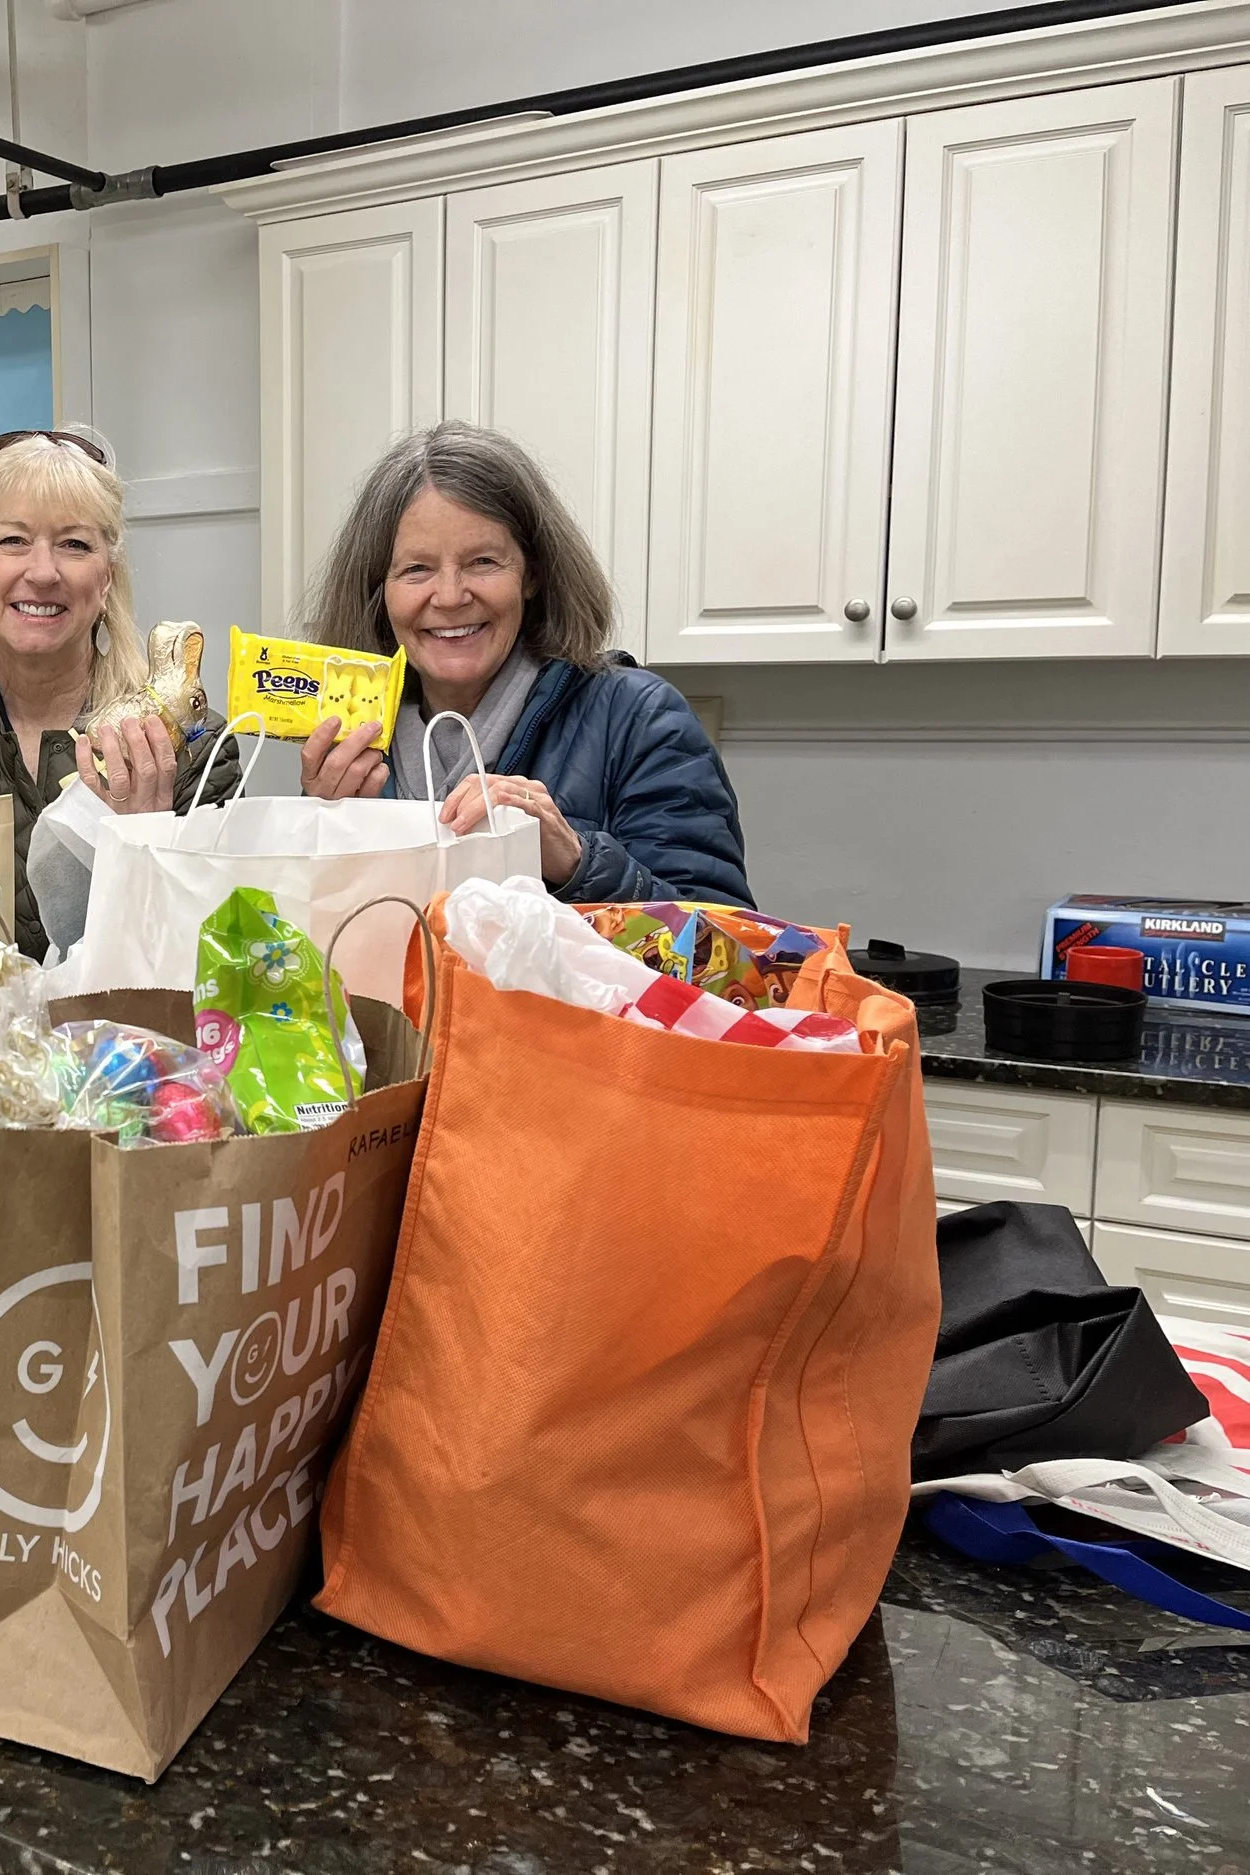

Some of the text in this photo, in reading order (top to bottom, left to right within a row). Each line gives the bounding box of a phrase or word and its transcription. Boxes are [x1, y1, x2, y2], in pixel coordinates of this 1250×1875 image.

[252, 669, 321, 694] Peeps
[263, 694, 306, 706] Marshmallow
[1055, 922, 1092, 953] PREMIUM
[1144, 917, 1224, 934] KIRKLAND
[297, 1103, 349, 1116] Nutrition
[174, 1171, 346, 1306] FIND
[17, 1340, 63, 1394] G
[169, 1267, 358, 1428] YOUR
[167, 1343, 368, 1549] HAPPY
[51, 1535, 102, 1603] HICKS
